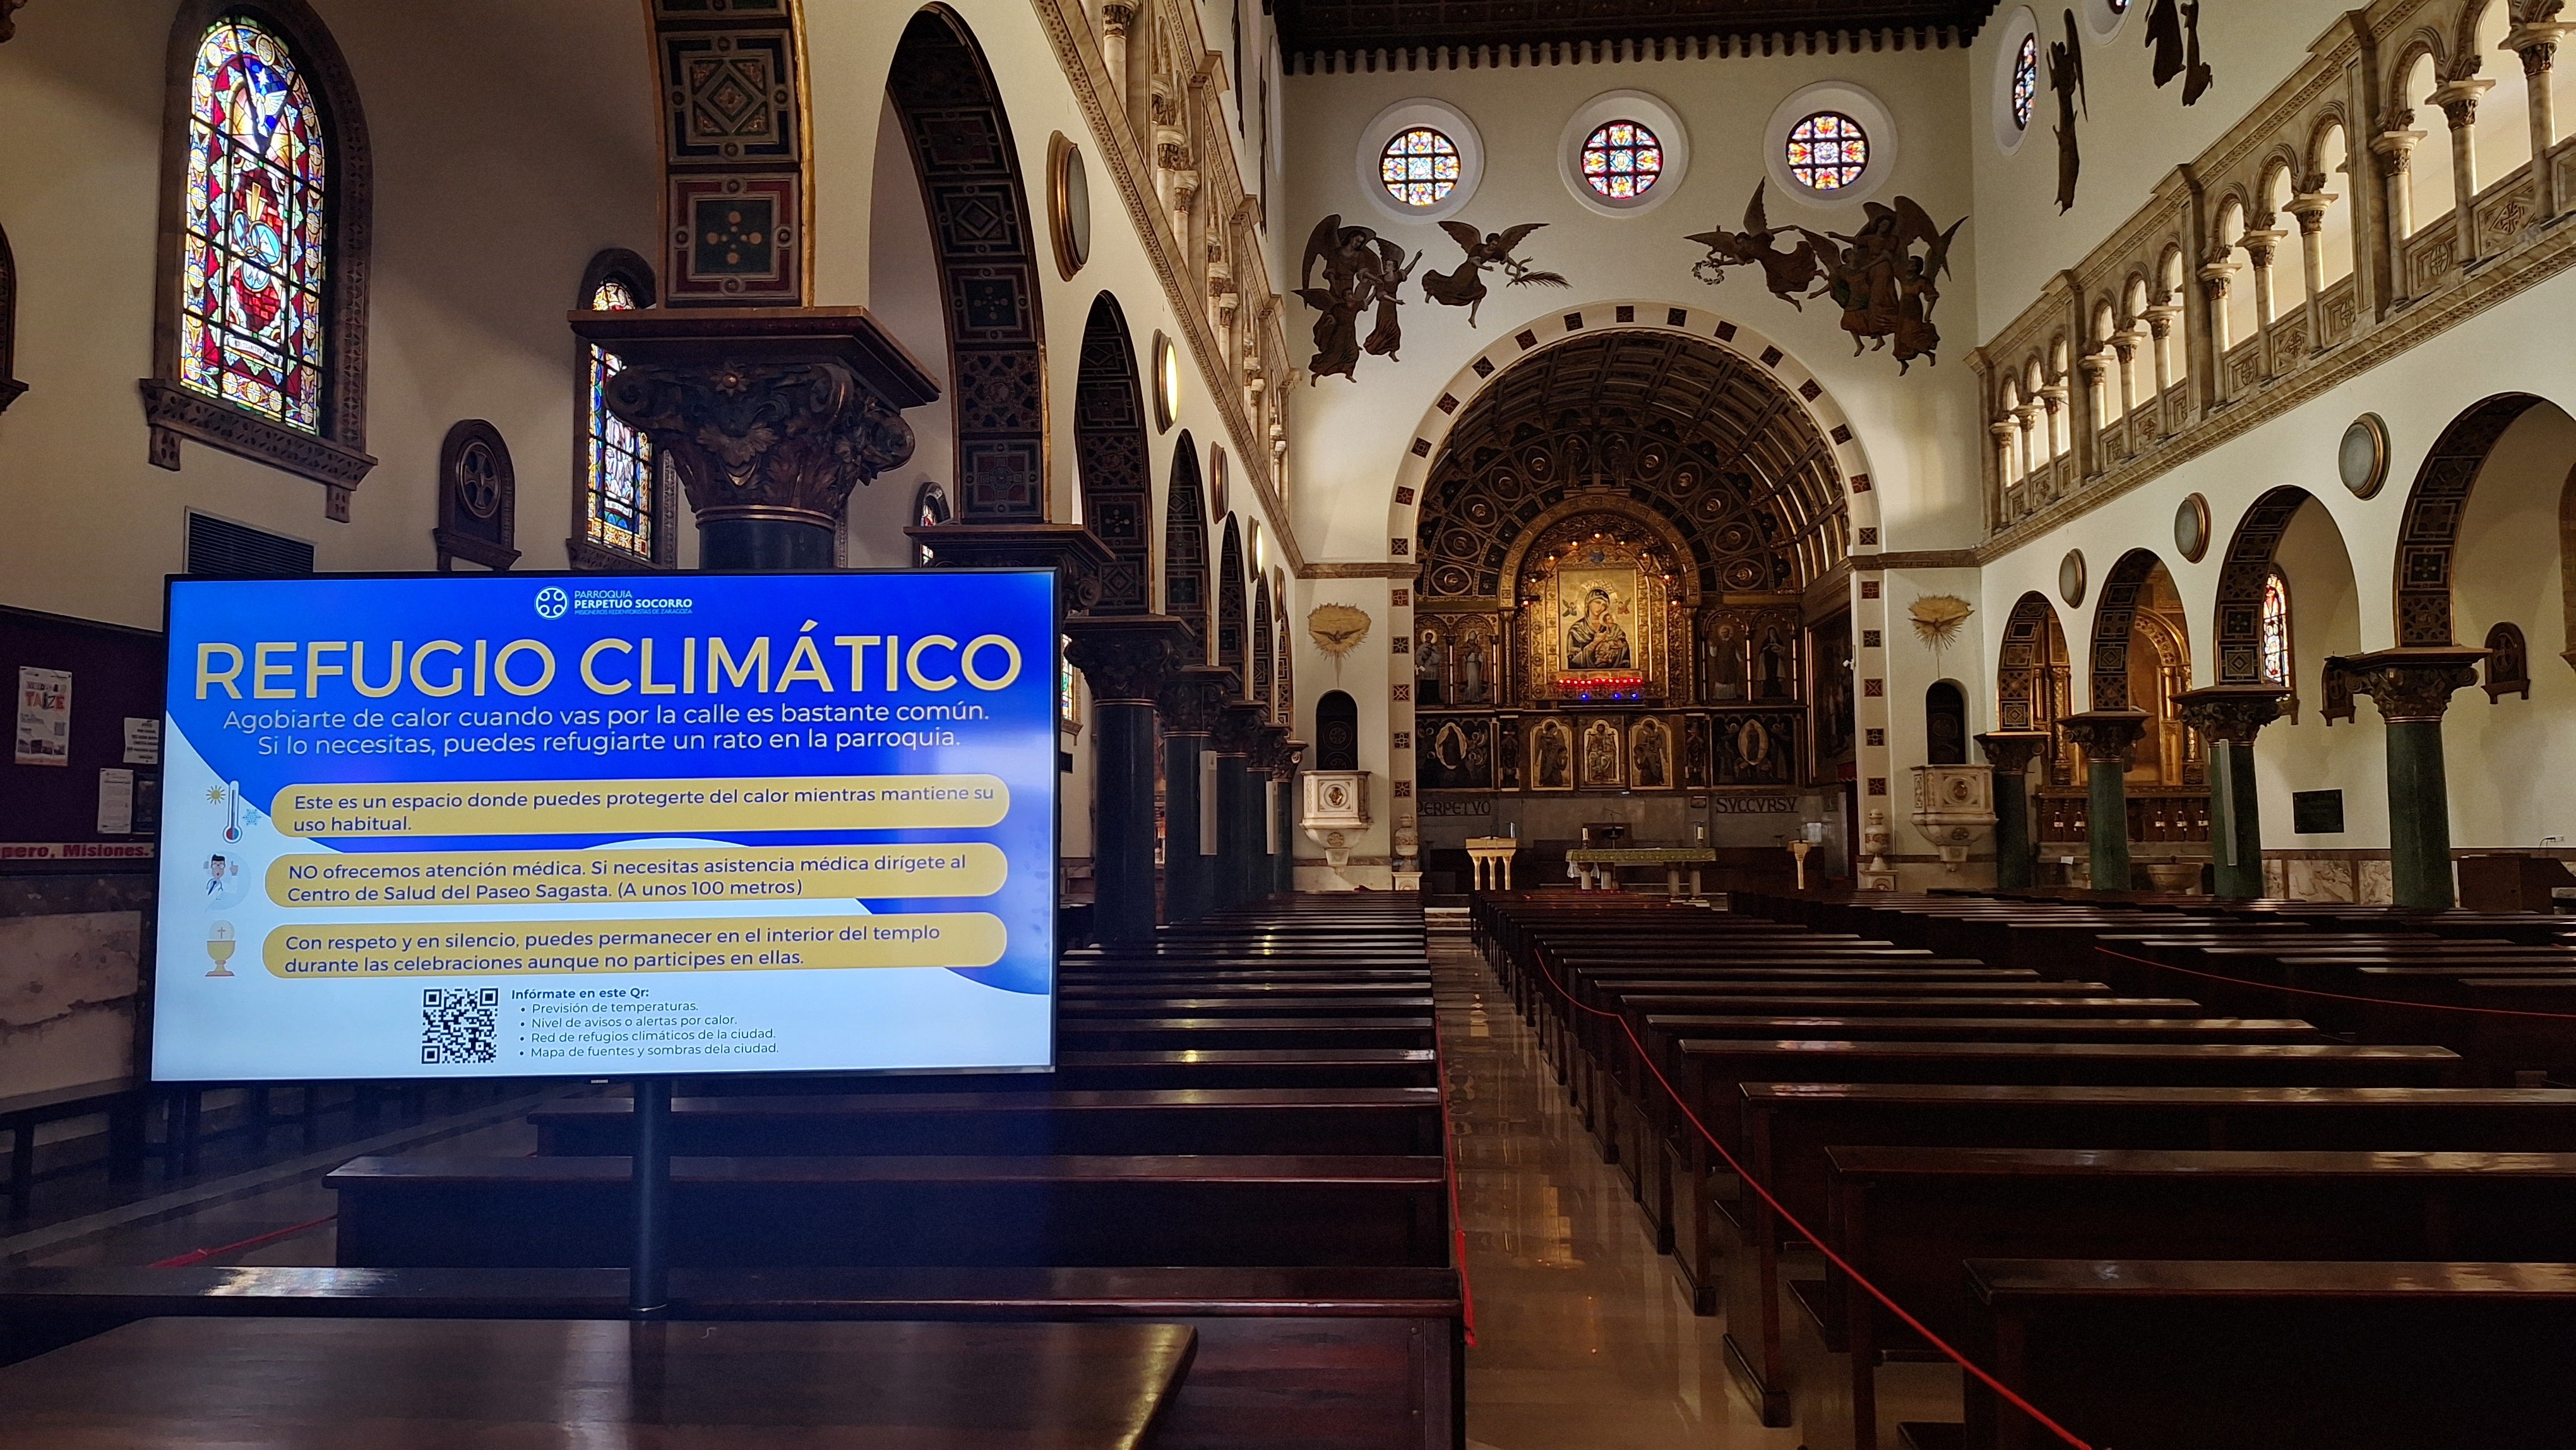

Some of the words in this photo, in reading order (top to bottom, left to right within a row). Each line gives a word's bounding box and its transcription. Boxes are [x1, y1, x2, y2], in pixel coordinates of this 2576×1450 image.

[574, 590, 633, 599] PARROQUIA
[574, 599, 633, 609] PERPETUO
[635, 599, 693, 608] SOCORRO
[195, 638, 556, 700] REFUGIO
[580, 619, 1022, 695] CLIMÁTICO
[223, 709, 346, 734] Agobiarte
[353, 708, 385, 728] de
[391, 707, 452, 728] calor
[458, 706, 553, 726] cuando
[559, 710, 600, 725] vas
[608, 709, 649, 729] por
[657, 704, 676, 724] la
[683, 704, 740, 724] calle
[747, 708, 774, 722] es
[782, 703, 890, 722] bastante
[896, 700, 989, 721] común.
[258, 735, 278, 755] Si
[287, 735, 307, 755] lo
[316, 734, 436, 756] necesitas,
[444, 732, 535, 757] puedes
[544, 731, 666, 755] refugiarte
[674, 734, 705, 750] un
[713, 731, 762, 749] rato
[769, 733, 799, 748] en
[809, 728, 827, 748] la
[837, 727, 960, 752] parroquia.
[295, 796, 333, 810] Este
[338, 798, 357, 809] es
[363, 798, 386, 808] un
[392, 793, 463, 812] espacio
[467, 792, 528, 807] donde
[534, 791, 601, 810] puedes
[607, 791, 705, 809] protegerte
[710, 788, 737, 803] del
[743, 788, 789, 803] calor
[794, 787, 876, 803] mientras
[881, 786, 969, 801] mantiene
[974, 788, 994, 800] su
[1716, 797, 1798, 813] SVCCVRSV
[294, 820, 325, 832] uso
[331, 815, 412, 831] habitual.
[289, 865, 318, 880] NO
[323, 864, 420, 879] ofrecemos
[426, 861, 506, 877] atención
[513, 860, 586, 877] médica.
[591, 860, 607, 875] Si
[614, 859, 699, 875] necesitas
[704, 856, 794, 873] asistencia
[801, 856, 868, 872] médica
[874, 854, 945, 873] dirígete
[950, 854, 965, 869] al
[288, 887, 350, 902] Centro
[355, 885, 379, 901] de
[383, 885, 436, 901] Salud
[441, 884, 470, 899] del
[476, 885, 530, 899] Paseo
[535, 884, 612, 901] Sagasta.
[618, 882, 637, 899] (A
[642, 885, 687, 896] unos
[691, 881, 724, 896] 100
[730, 878, 802, 896] metros)
[285, 936, 322, 950] Con
[328, 935, 397, 953] respeto
[402, 937, 412, 952] y
[417, 937, 439, 949] en
[445, 932, 519, 949] silencio,
[525, 931, 593, 950] puedes
[599, 932, 713, 949] permanecer
[717, 932, 739, 943] en
[745, 927, 760, 942] el
[767, 926, 835, 942] interior
[839, 925, 867, 941] del
[873, 924, 940, 943] templo
[285, 957, 359, 973] durante
[364, 957, 389, 972] las
[393, 954, 523, 971] celebraciones
[528, 957, 599, 972] aunque
[605, 956, 628, 968] no
[635, 951, 725, 970] participes
[731, 952, 753, 966] en
[759, 950, 803, 965] ellas.
[511, 988, 576, 1000] Infórmate
[579, 990, 595, 998] en
[599, 988, 627, 998] este
[629, 987, 649, 999] Qr:
[532, 1002, 588, 1014] Previsión
[592, 1002, 608, 1013] de
[611, 1002, 698, 1014] temperaturas.
[532, 1017, 562, 1029] Nivel
[565, 1017, 581, 1028] de
[584, 1016, 622, 1028] avisos
[624, 1019, 633, 1027] o
[636, 1016, 677, 1026] alertas
[681, 1017, 701, 1028] por
[705, 1014, 737, 1025] calor.
[532, 1032, 556, 1043] Red
[559, 1032, 575, 1043] de
[578, 1031, 629, 1043] refugios
[631, 1029, 695, 1041] climáticos
[698, 1029, 714, 1040] de
[717, 1029, 727, 1040] la
[730, 1028, 776, 1039] ciudad.
[531, 1047, 565, 1060] Mapa
[568, 1046, 585, 1057] de
[588, 1046, 635, 1057] fuentes
[636, 1048, 645, 1058] y
[647, 1044, 701, 1055] sombras
[704, 1043, 730, 1054] dela
[734, 1042, 778, 1053] ciudad.
